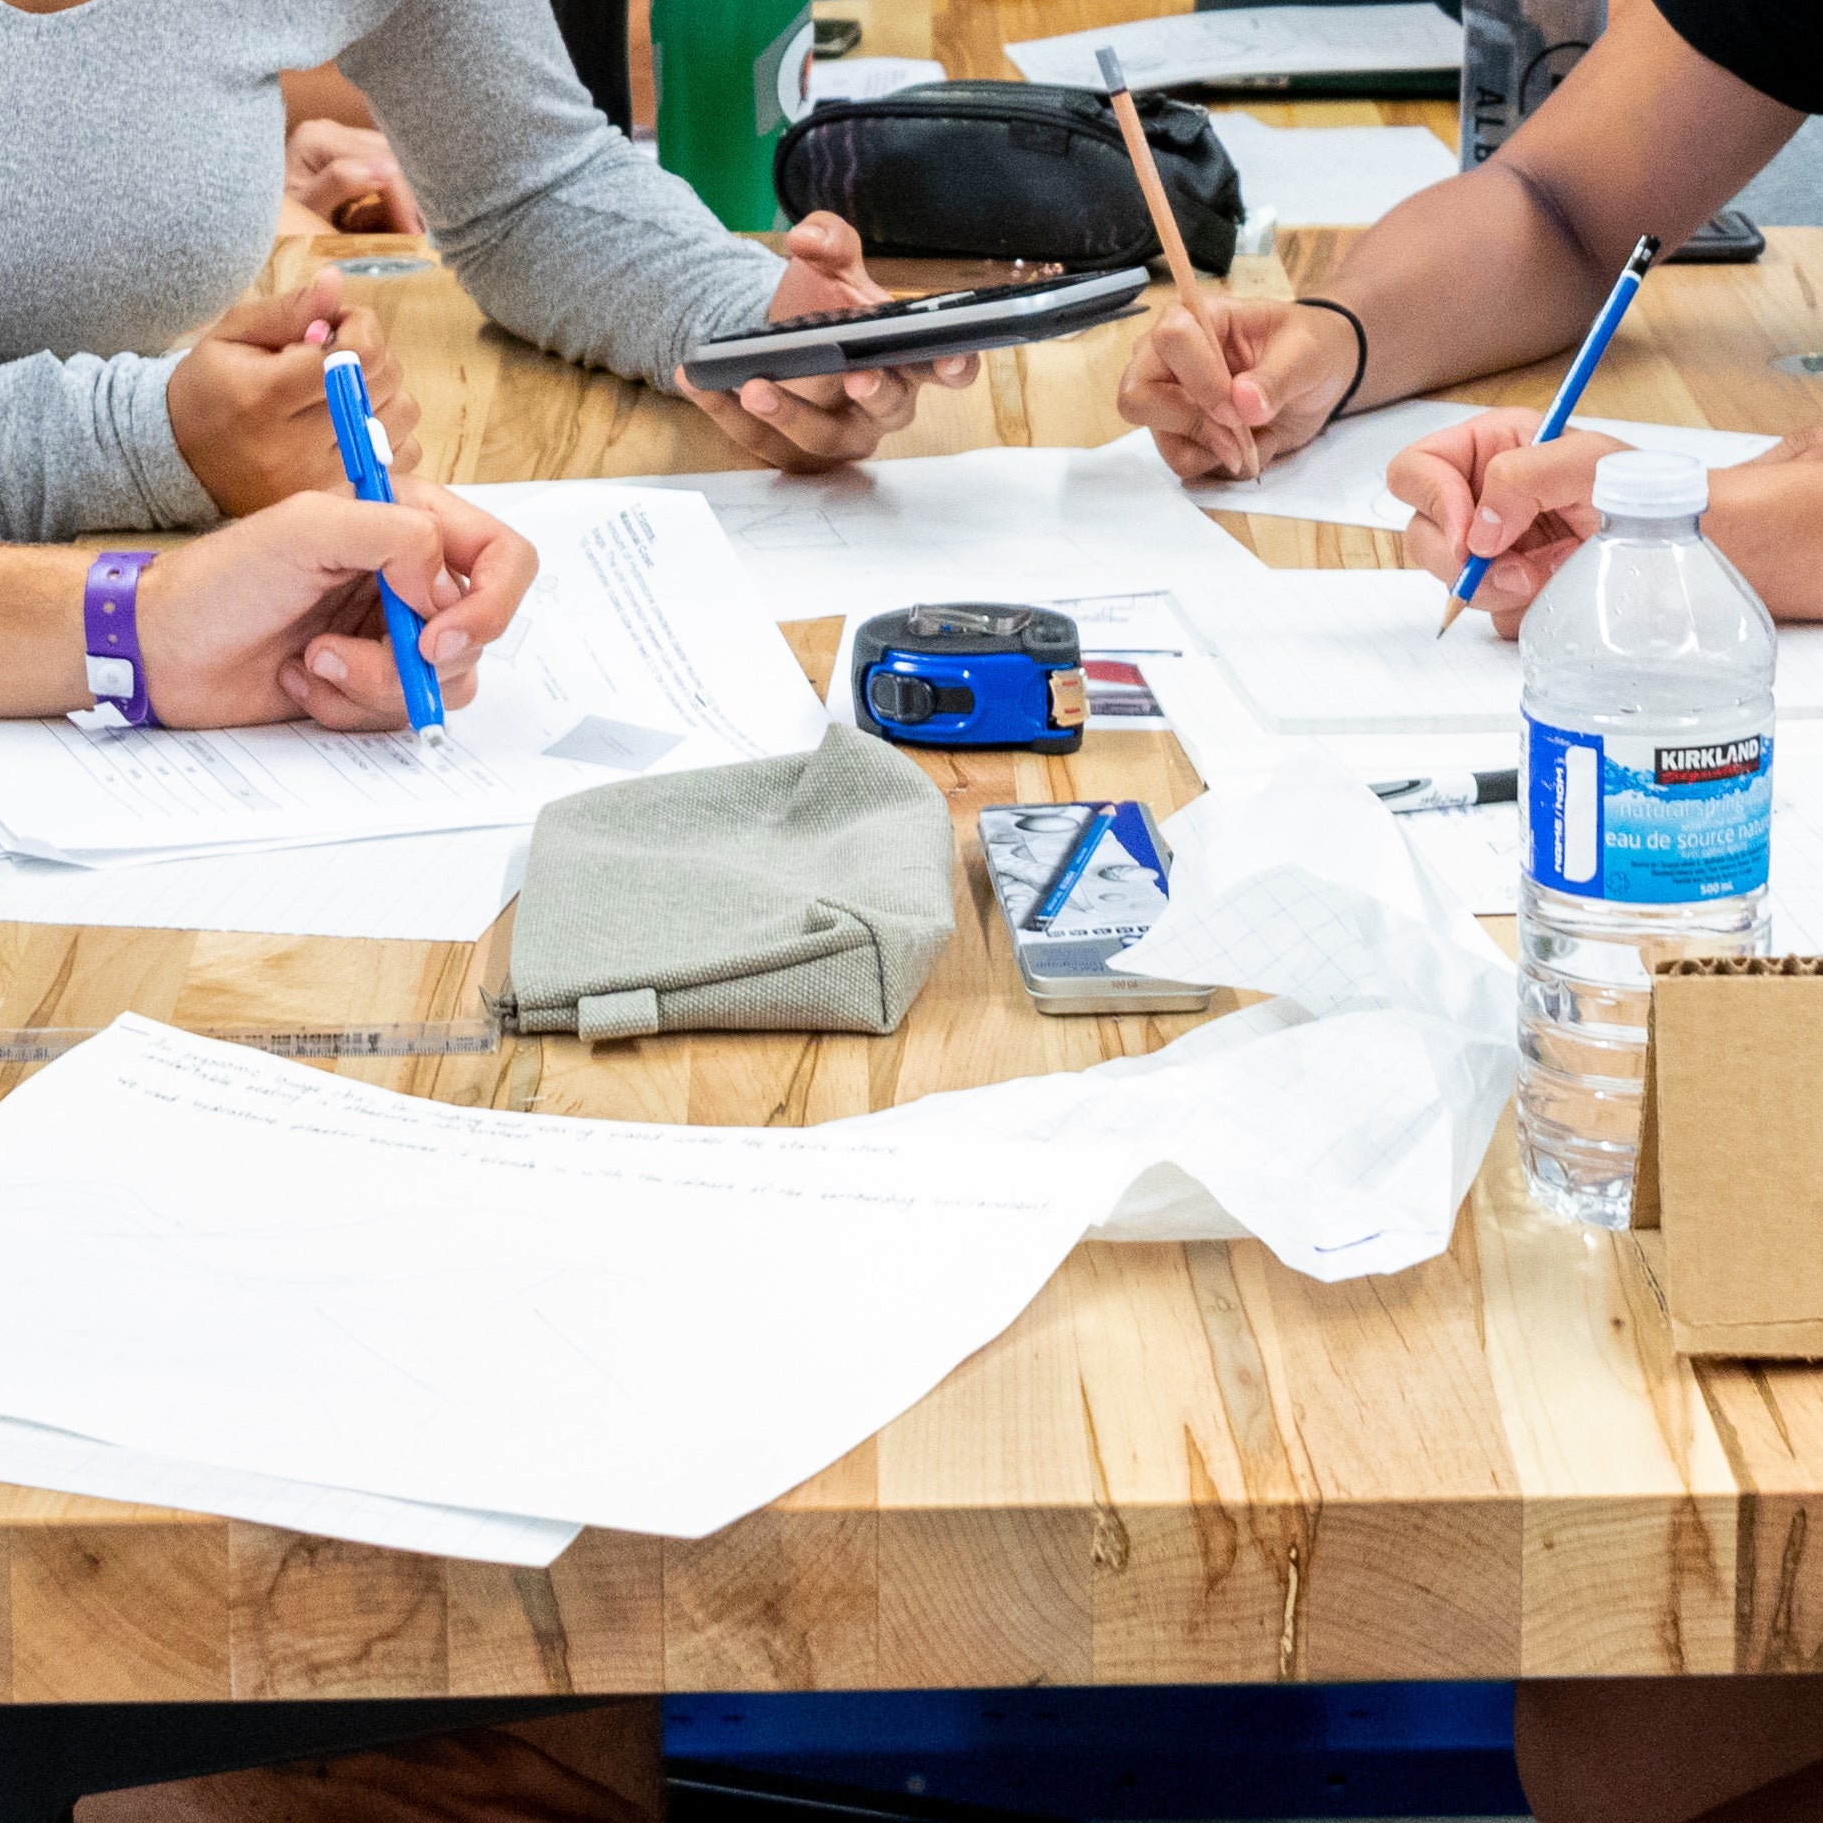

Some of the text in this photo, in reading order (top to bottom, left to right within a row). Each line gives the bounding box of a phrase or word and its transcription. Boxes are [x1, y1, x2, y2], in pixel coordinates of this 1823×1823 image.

[620, 511, 641, 545] Material
[1661, 739, 1759, 771] KIRKLAND
[1620, 798, 1688, 818] natural
[1692, 793, 1745, 819] spring
[1554, 819, 1565, 873] NAME
[1605, 833, 1641, 849] eau
[1646, 830, 1671, 849] de
[1677, 826, 1734, 850] source
[1700, 882, 1720, 895] 500
